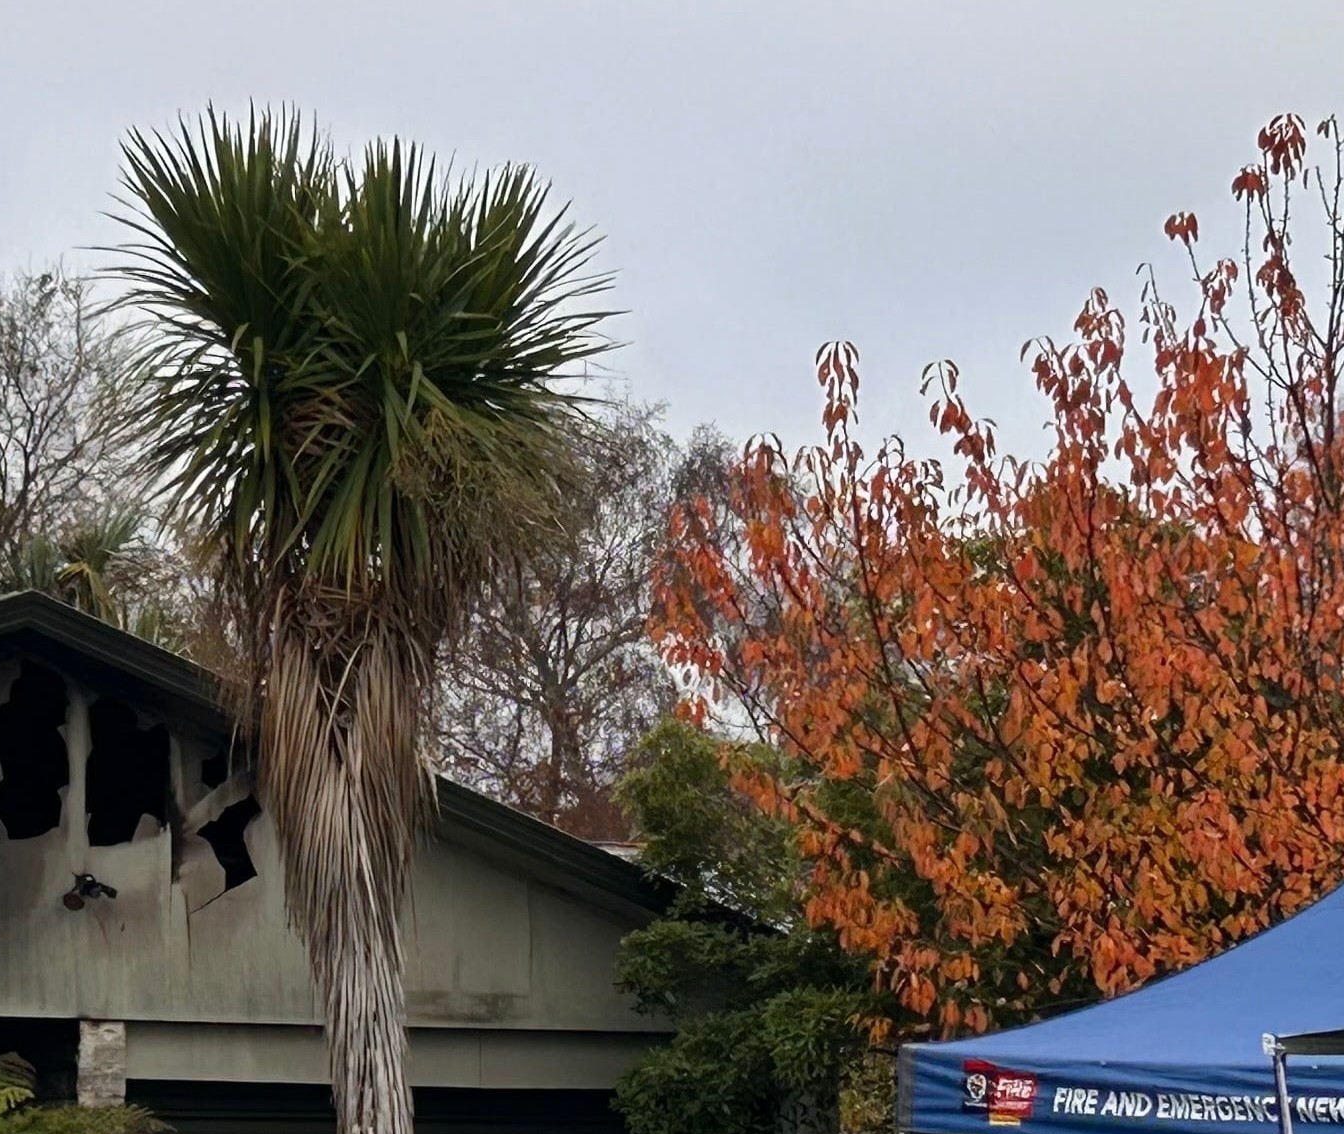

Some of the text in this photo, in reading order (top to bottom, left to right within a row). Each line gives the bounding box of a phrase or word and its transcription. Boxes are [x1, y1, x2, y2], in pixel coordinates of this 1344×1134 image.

[1053, 1087, 1099, 1115] FIRE
[1100, 1091, 1154, 1117] AND
[1156, 1093, 1293, 1123] EMERGENC
